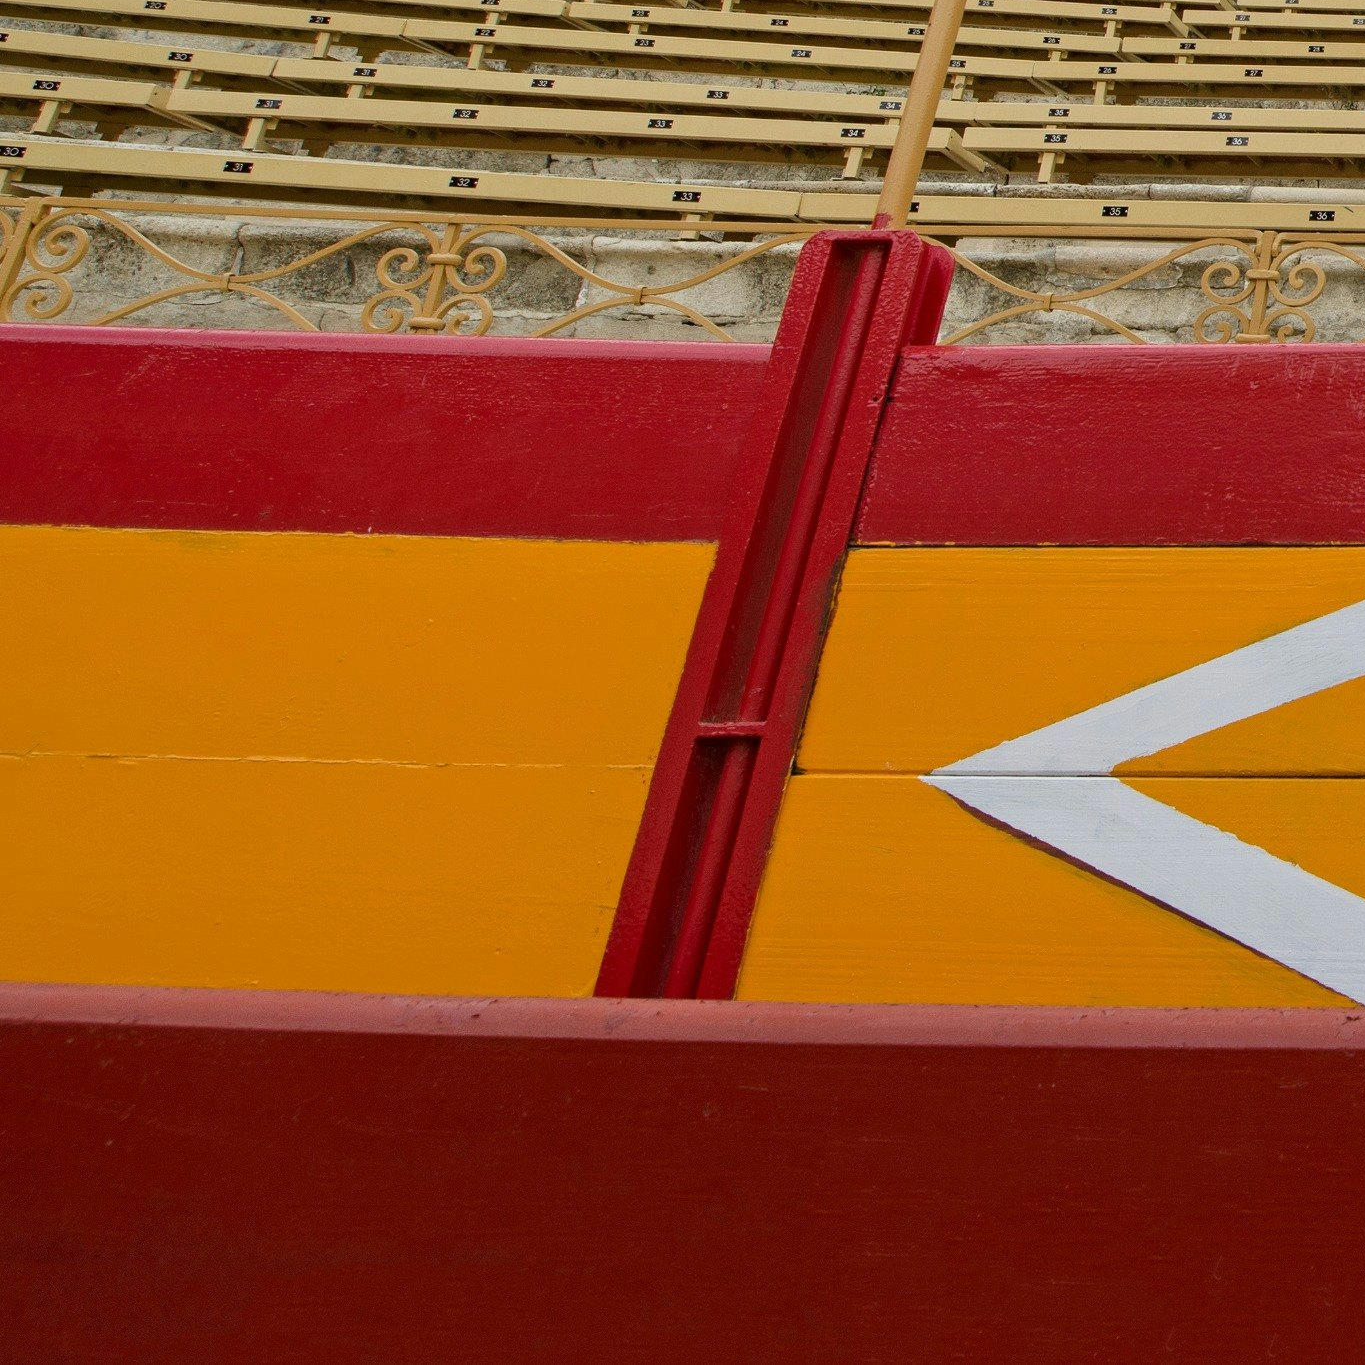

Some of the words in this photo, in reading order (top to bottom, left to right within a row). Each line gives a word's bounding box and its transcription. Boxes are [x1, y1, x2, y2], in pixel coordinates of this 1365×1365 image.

[174, 52, 188, 61] 30
[39, 81, 55, 90] 30
[263, 100, 274, 108] 31
[460, 110, 472, 118] 32
[655, 120, 667, 128] 33
[847, 129, 859, 137] 34
[3, 147, 20, 156] 30
[232, 162, 244, 172] 31
[457, 178, 471, 187] 32
[680, 192, 693, 201] 33
[1109, 207, 1121, 216] 35
[1316, 211, 1328, 220] 36
